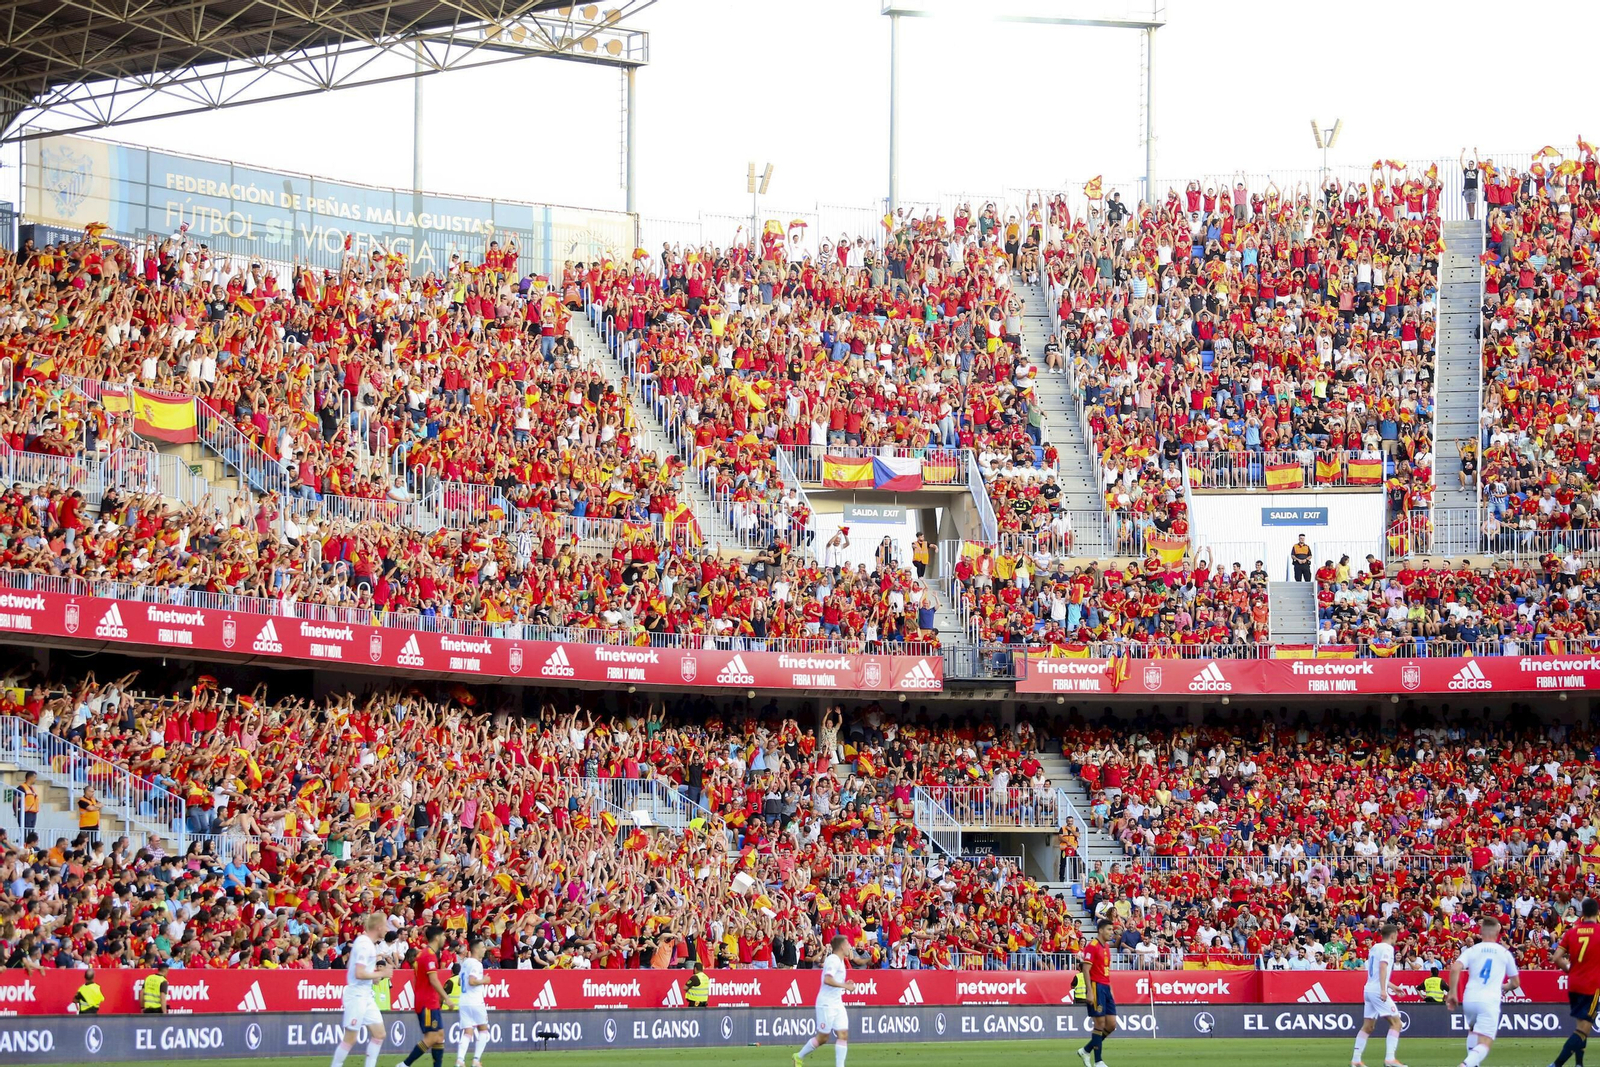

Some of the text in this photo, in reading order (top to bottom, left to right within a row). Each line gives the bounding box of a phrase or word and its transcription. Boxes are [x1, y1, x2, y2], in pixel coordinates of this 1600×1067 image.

[166, 173, 494, 235] FEDERACIÓN DE PEÑAS MALAGUISTAS
[165, 197, 257, 241] FÚTBOL
[852, 508, 878, 517] SALIDA
[1303, 511, 1321, 519] EXIT
[147, 605, 205, 626] finetwork
[96, 625, 128, 639] adidas
[158, 628, 173, 643] FIBRA
[177, 629, 193, 645] MÓVIL
[300, 621, 353, 641] finetwork
[253, 640, 283, 653] adidas
[310, 643, 325, 657] FIBRA
[328, 644, 342, 659] MÓVIL
[440, 636, 492, 654] finetwork
[397, 654, 424, 666] adidas
[594, 646, 659, 664] finetwork
[778, 654, 851, 670] finetwork
[449, 657, 463, 670] FIBRA
[467, 657, 481, 671] MÓVIL
[541, 666, 574, 677] adidas
[1291, 661, 1374, 675] finetwork
[1519, 656, 1600, 672] finetwork
[607, 667, 623, 680] FIBRA
[628, 666, 646, 681] MÓVIL
[716, 673, 755, 684] adidas
[792, 673, 811, 686] FIBRA
[816, 673, 837, 686] MÓVIL
[1536, 676, 1558, 688] FIBRA
[1563, 674, 1587, 688] MÓVIL
[901, 678, 942, 689] adidas
[1052, 678, 1073, 690] FIBRA
[1078, 677, 1101, 691] MÓVIL
[1189, 680, 1232, 691] adidas
[1308, 679, 1329, 691] FIBRA
[1335, 677, 1358, 691] MÓVIL
[1448, 679, 1492, 690] adidas
[1578, 936, 1590, 962] 7
[1480, 958, 1493, 984] 4
[583, 978, 641, 998] finetwork
[708, 978, 761, 996] finetwork
[1136, 978, 1230, 995] finetwork
[633, 1021, 648, 1039] EL
[755, 1019, 770, 1037] EL
[862, 1016, 876, 1034] EL
[961, 1016, 980, 1034] EL
[1056, 1015, 1079, 1031] EL
[1243, 1014, 1269, 1030] EL
[136, 1029, 156, 1050] EL
[287, 1025, 306, 1045] EL
[511, 1022, 528, 1042] EL
